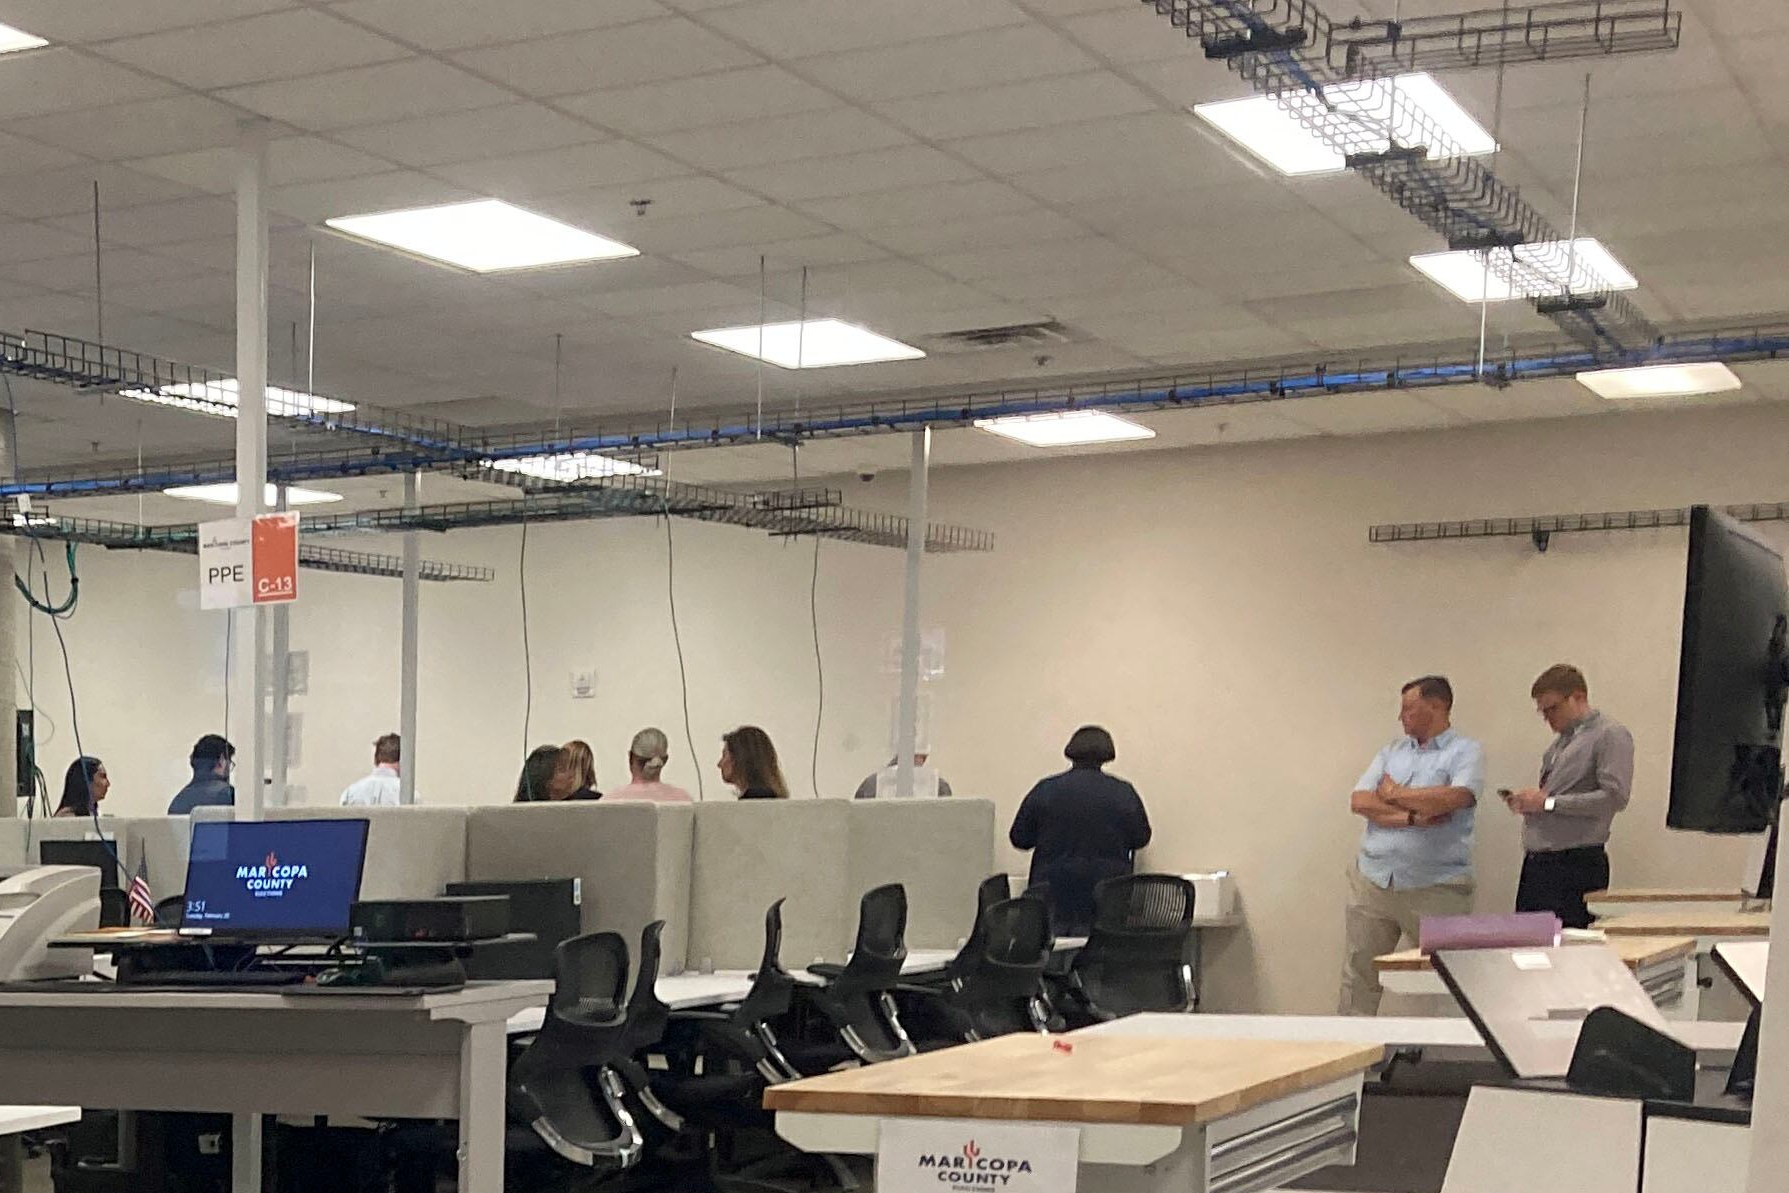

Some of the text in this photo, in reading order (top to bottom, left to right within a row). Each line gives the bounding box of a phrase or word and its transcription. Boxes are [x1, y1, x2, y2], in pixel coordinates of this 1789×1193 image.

[208, 564, 245, 584] PPE
[257, 576, 293, 593] C-13
[246, 878, 294, 890] COUNTY
[937, 1171, 1011, 1186] COUNTY
